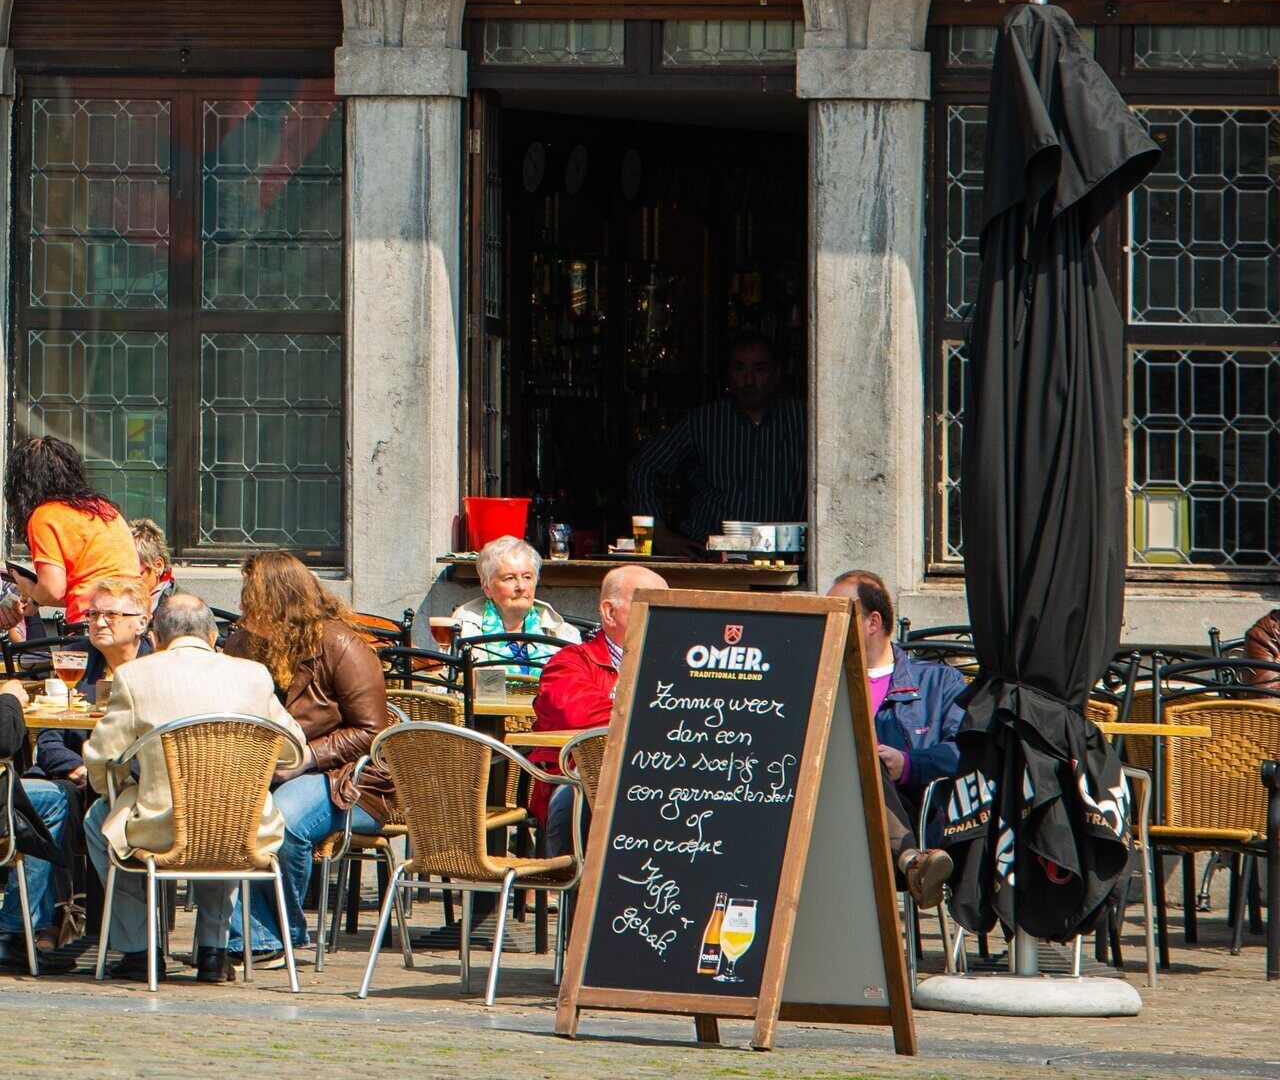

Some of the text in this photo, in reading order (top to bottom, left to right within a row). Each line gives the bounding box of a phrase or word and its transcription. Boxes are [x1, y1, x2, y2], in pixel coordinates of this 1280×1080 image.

[687, 644, 771, 671] OMER.
[689, 670, 763, 681] TRADITIONAL BLOND
[649, 681, 786, 727] Zonnig weer
[666, 720, 753, 746] dan een
[631, 750, 686, 770] vers
[767, 754, 797, 790] of
[686, 810, 714, 844] of
[613, 834, 648, 850] een
